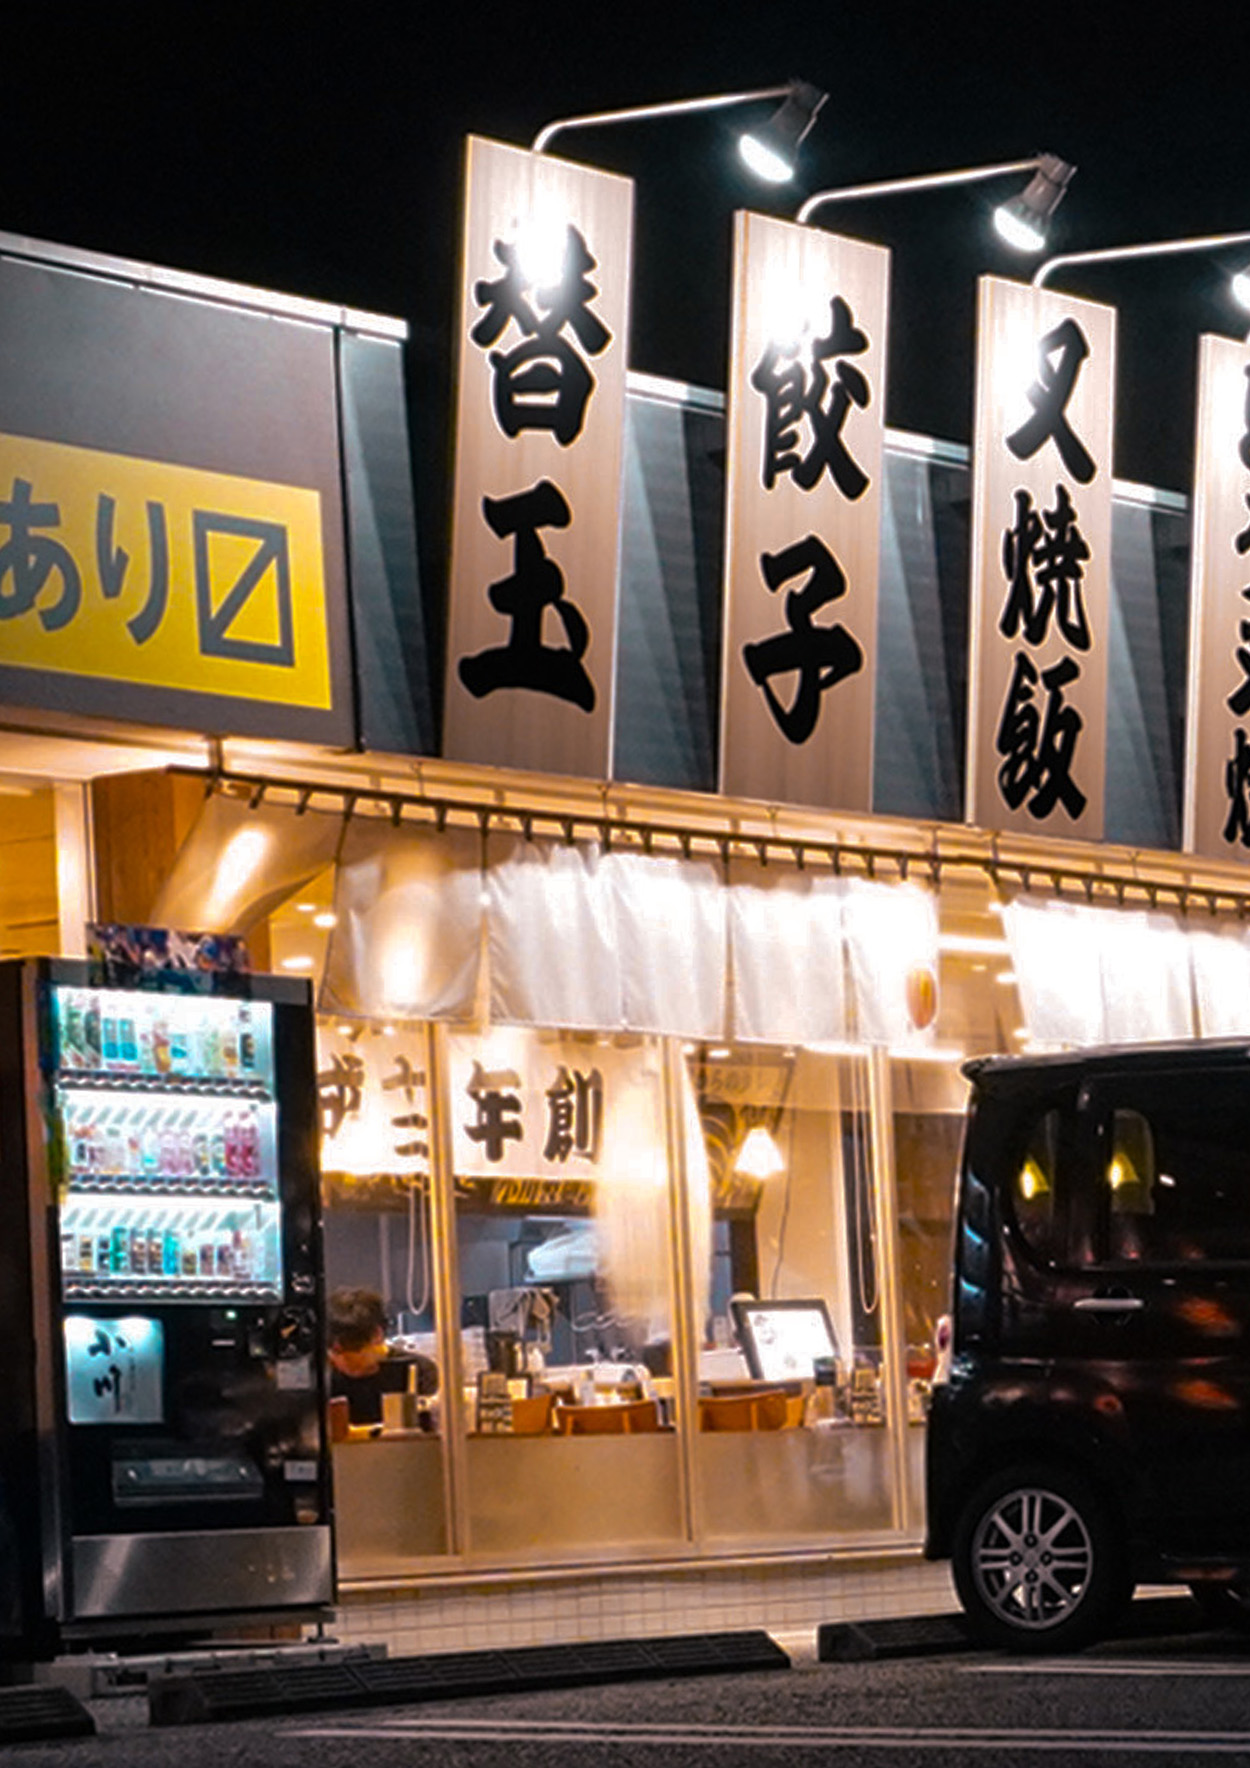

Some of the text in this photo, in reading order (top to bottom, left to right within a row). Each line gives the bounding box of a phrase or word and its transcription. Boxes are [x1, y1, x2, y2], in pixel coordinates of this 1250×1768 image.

[458, 218, 613, 713] 替玉
[742, 296, 871, 745] 餃子
[994, 317, 1097, 820] 叉焼飯
[87, 1328, 128, 1413] 小川
